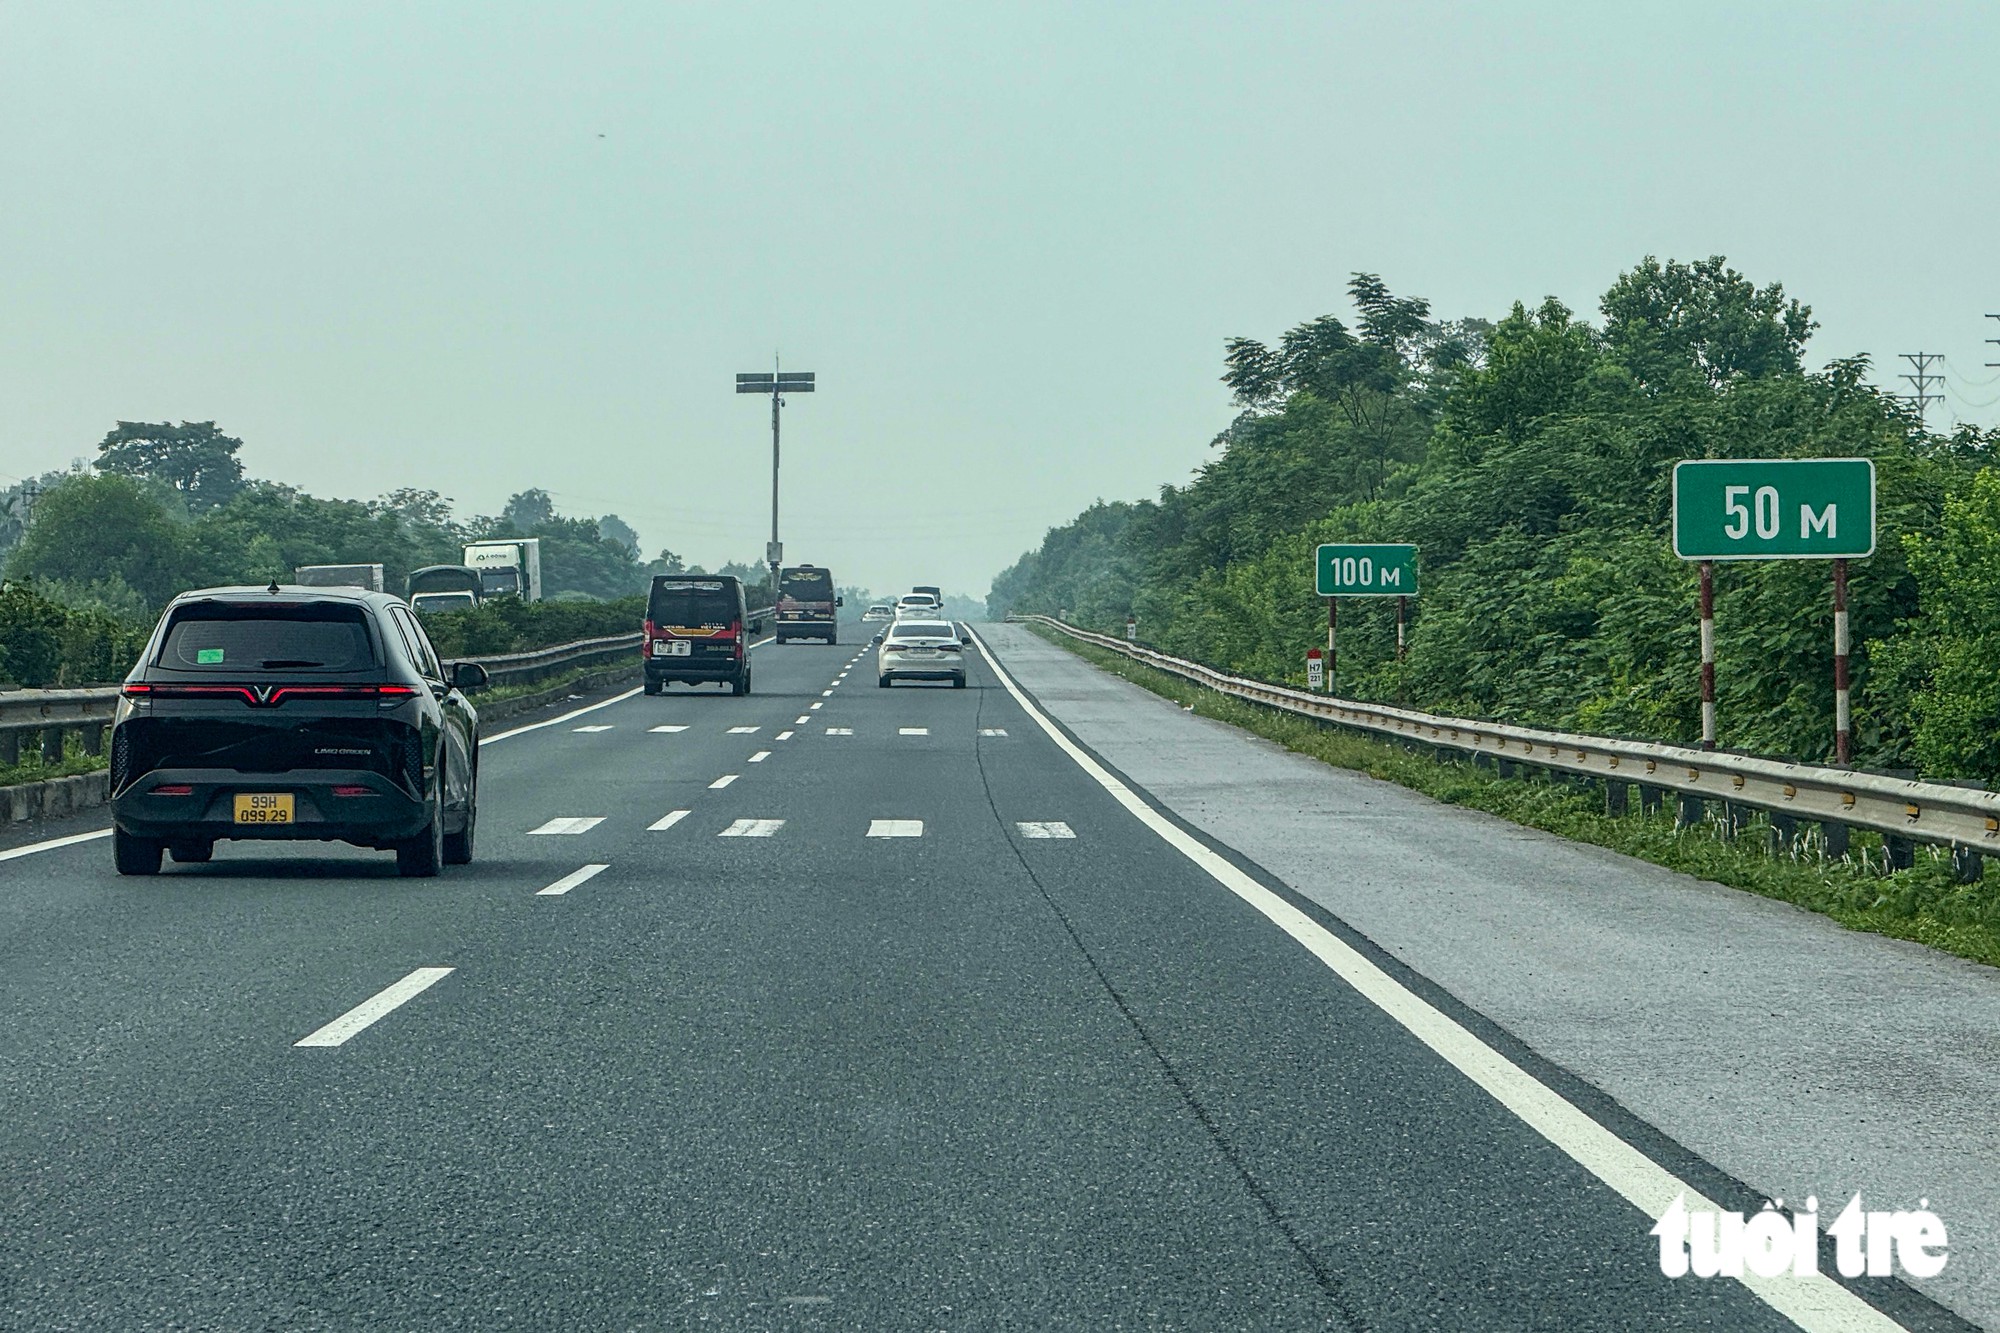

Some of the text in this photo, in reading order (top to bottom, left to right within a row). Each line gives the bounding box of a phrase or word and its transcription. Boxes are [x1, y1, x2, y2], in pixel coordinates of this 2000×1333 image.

[1725, 486, 1837, 540] 50 M
[1331, 557, 1400, 586] 100 M
[251, 796, 277, 809] 99H
[241, 809, 288, 822] 099.29
